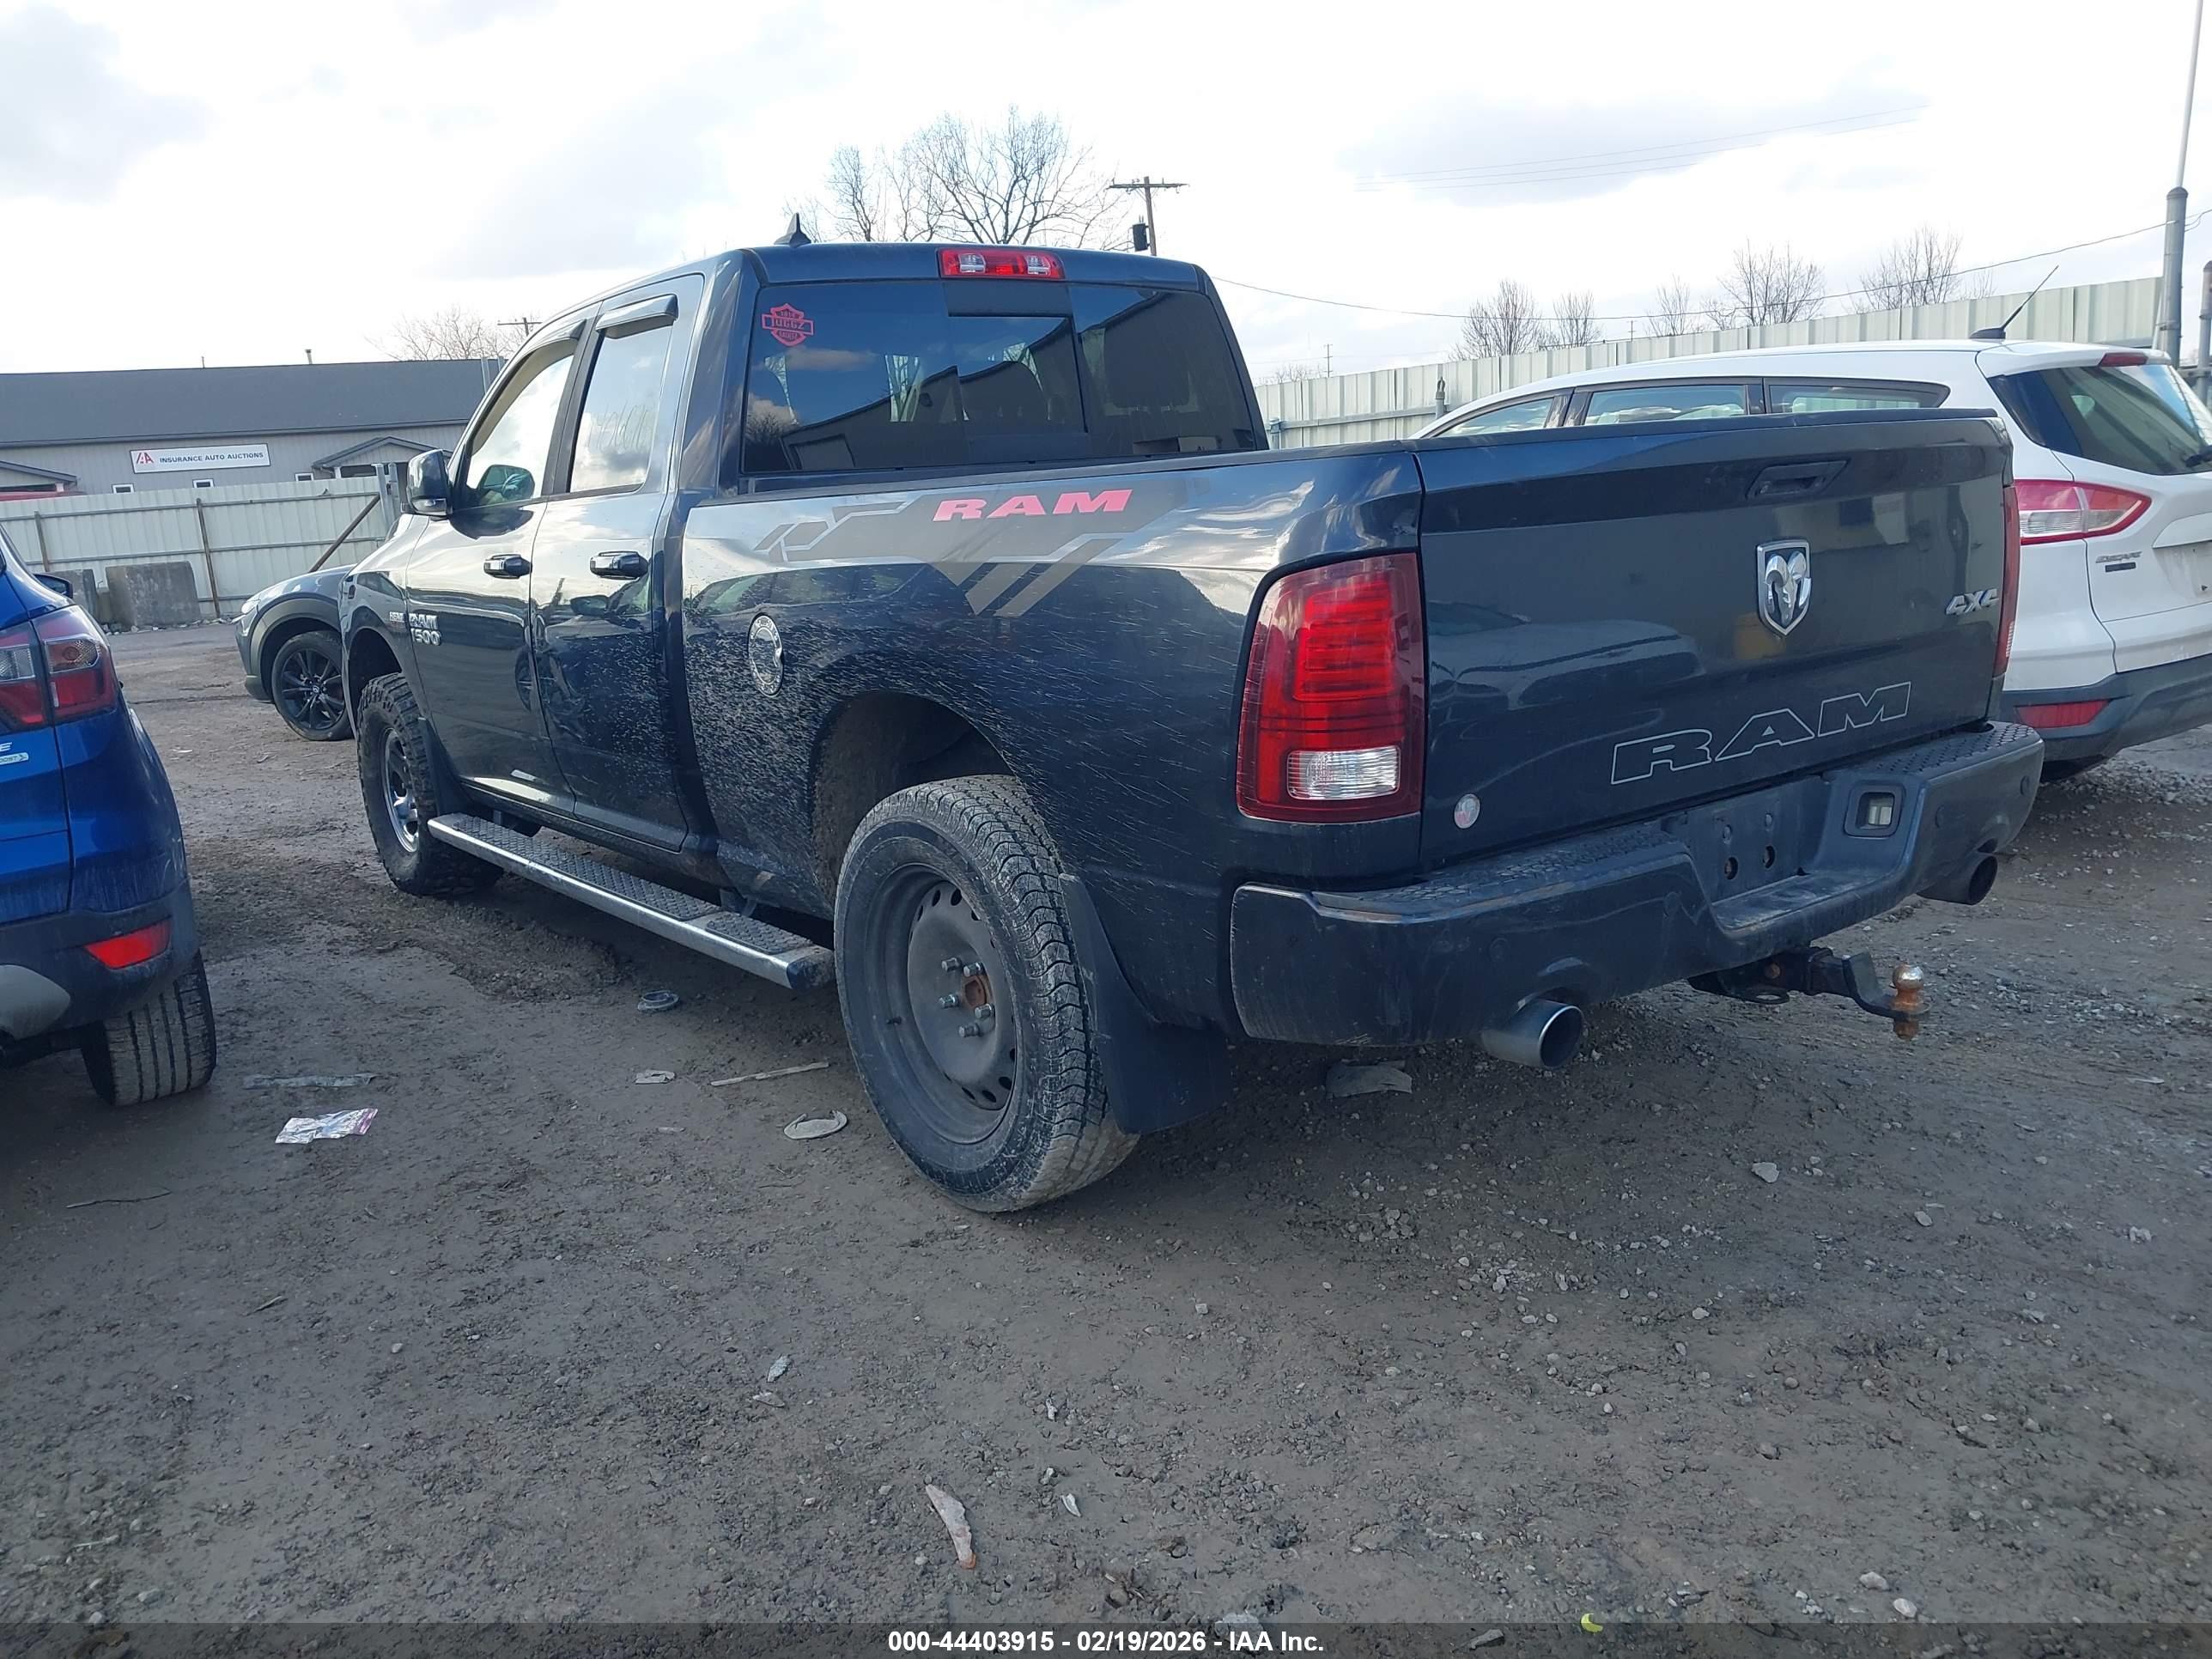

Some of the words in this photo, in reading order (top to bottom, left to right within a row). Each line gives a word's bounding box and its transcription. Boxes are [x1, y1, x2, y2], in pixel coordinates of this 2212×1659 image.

[159, 454, 203, 464] INSURANCE
[204, 453, 225, 462] AUTO
[227, 452, 264, 460] AUCTIONS
[933, 489, 1133, 522] RAM
[409, 613, 438, 630] RAM
[410, 628, 441, 646] 1500
[1611, 681, 1911, 785] RAM
